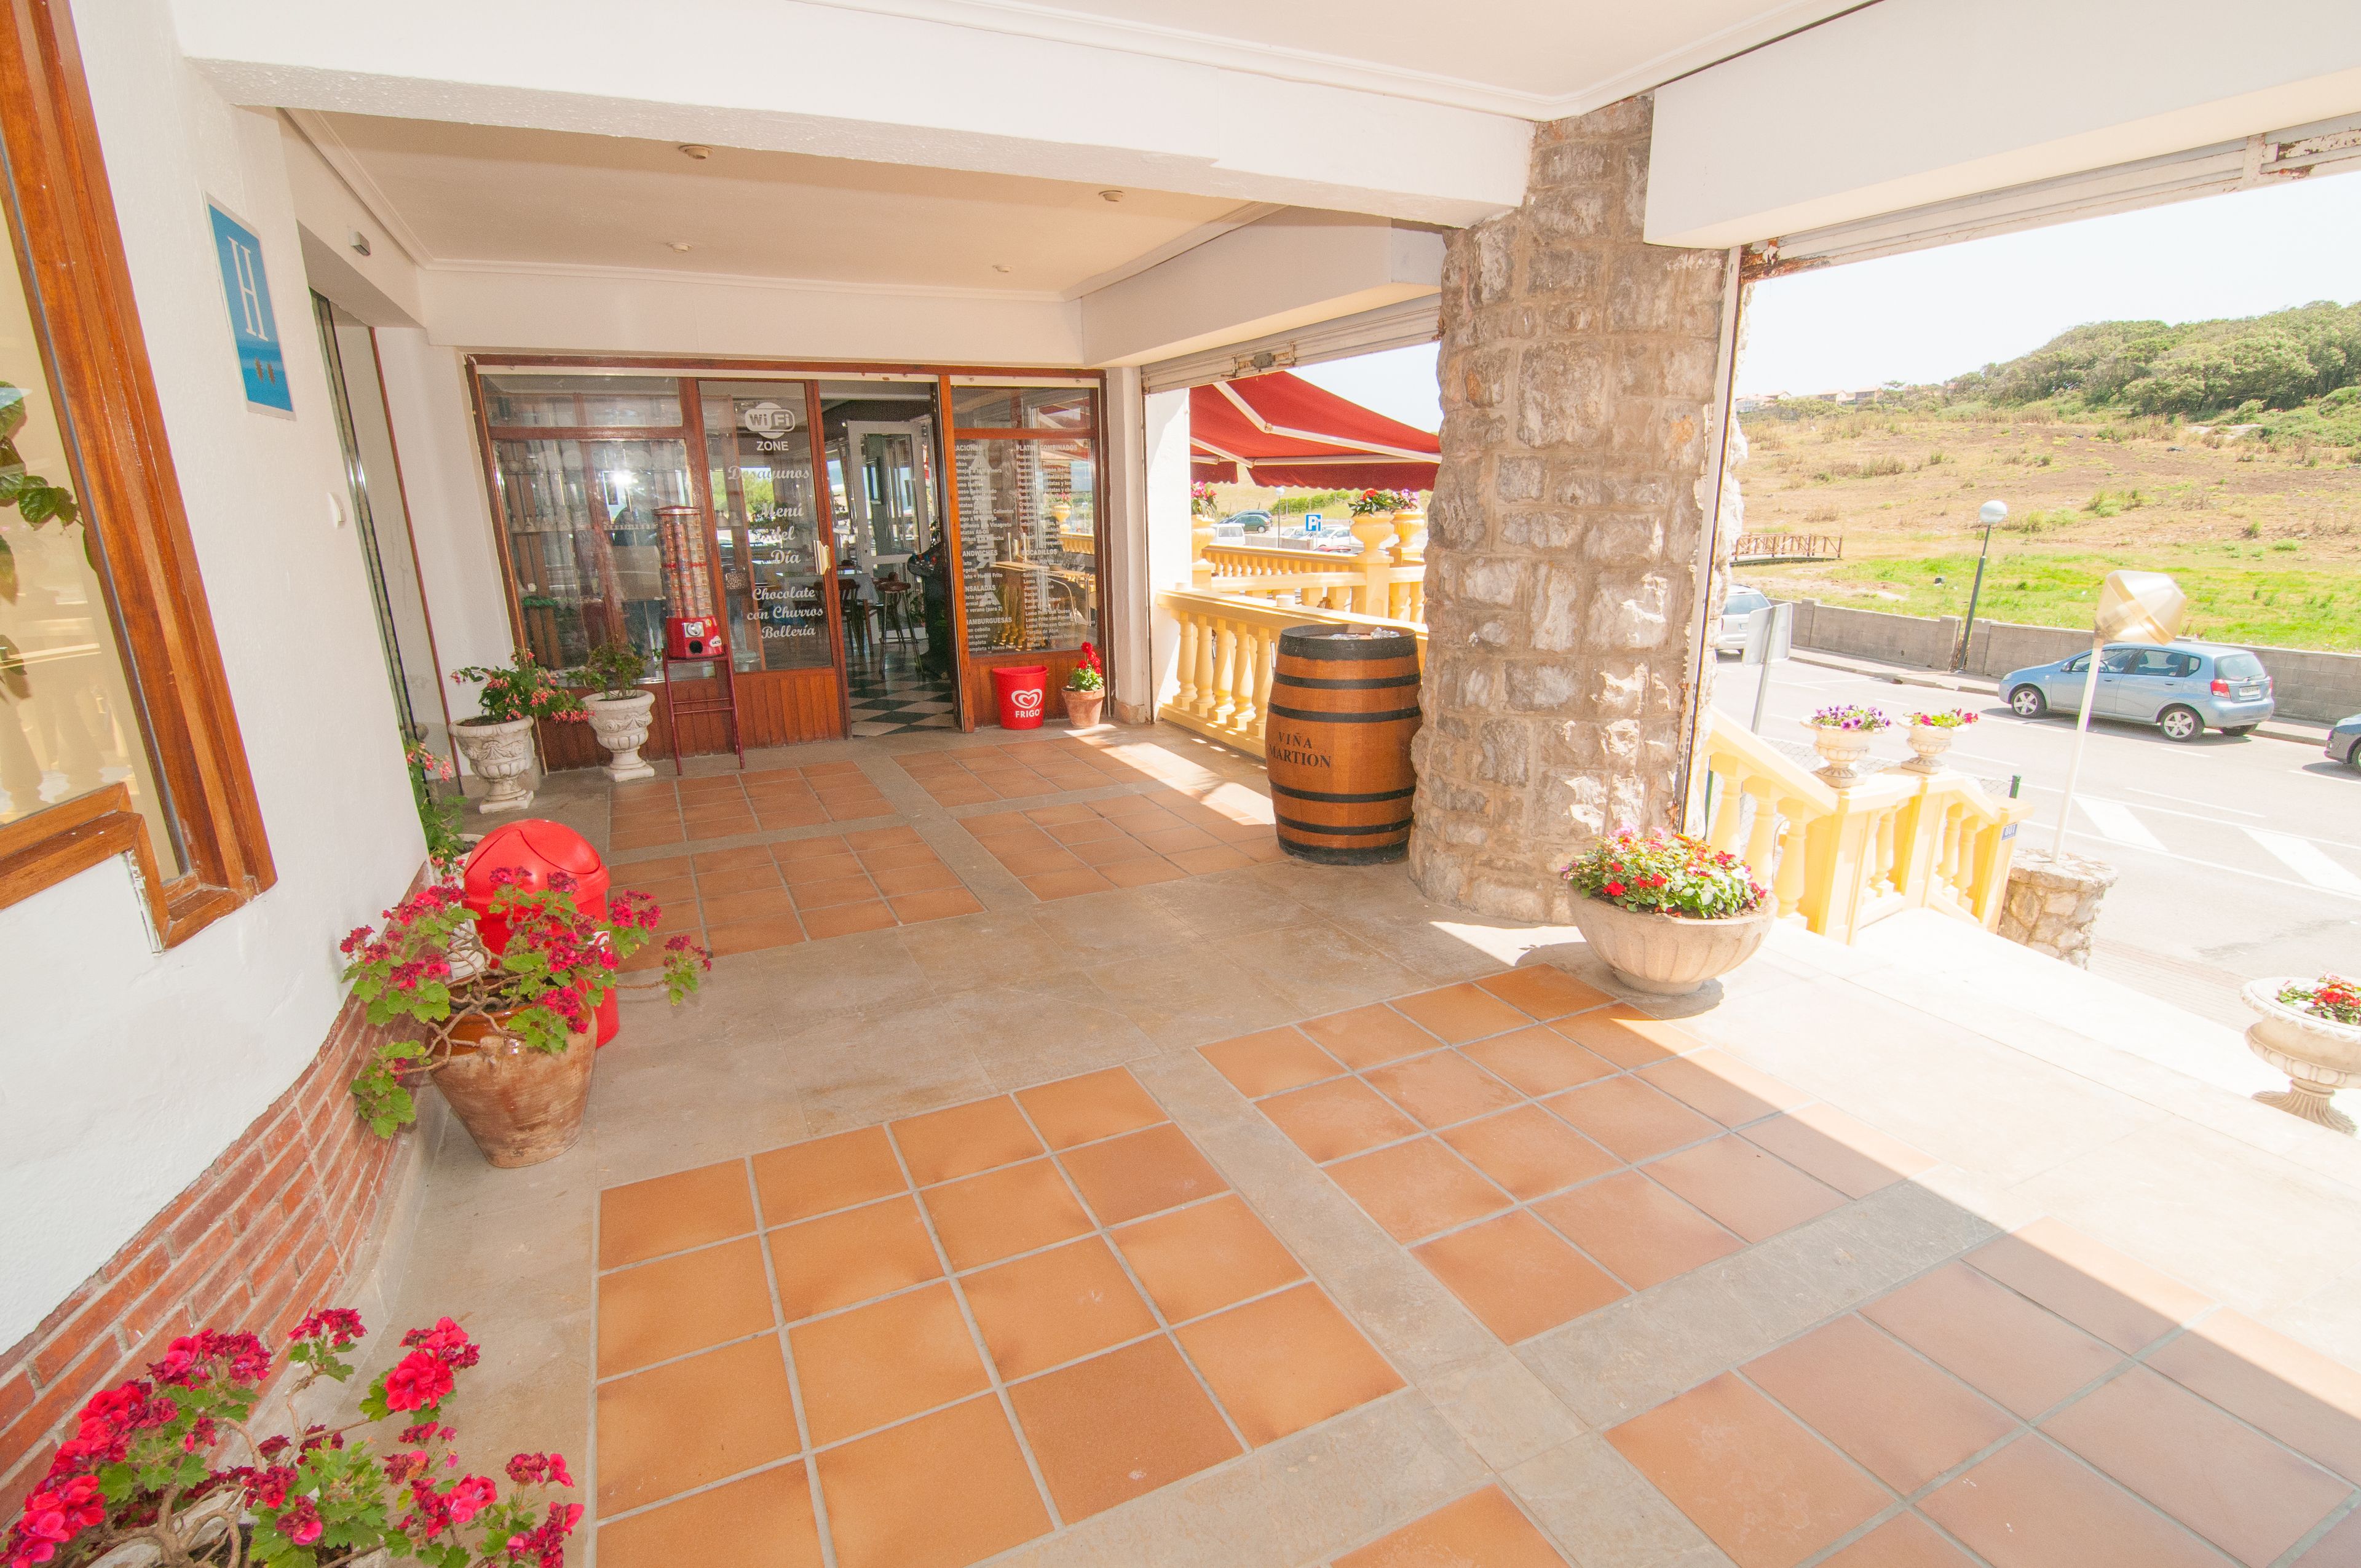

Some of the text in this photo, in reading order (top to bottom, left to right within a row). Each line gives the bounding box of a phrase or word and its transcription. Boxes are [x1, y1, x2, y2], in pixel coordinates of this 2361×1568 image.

[227, 236, 269, 342] H
[756, 441, 789, 451] ZONE
[727, 465, 810, 483] Desayunos
[757, 502, 805, 518] Menú
[1308, 515, 1318, 530] P
[770, 549, 801, 564] Día
[752, 586, 816, 600] Chocolate
[746, 606, 823, 620] con Churros
[761, 624, 816, 639] Bollería
[1015, 708, 1040, 718] FRIGO
[1279, 731, 1313, 749] VIÑA
[1269, 743, 1331, 769] MARTION
